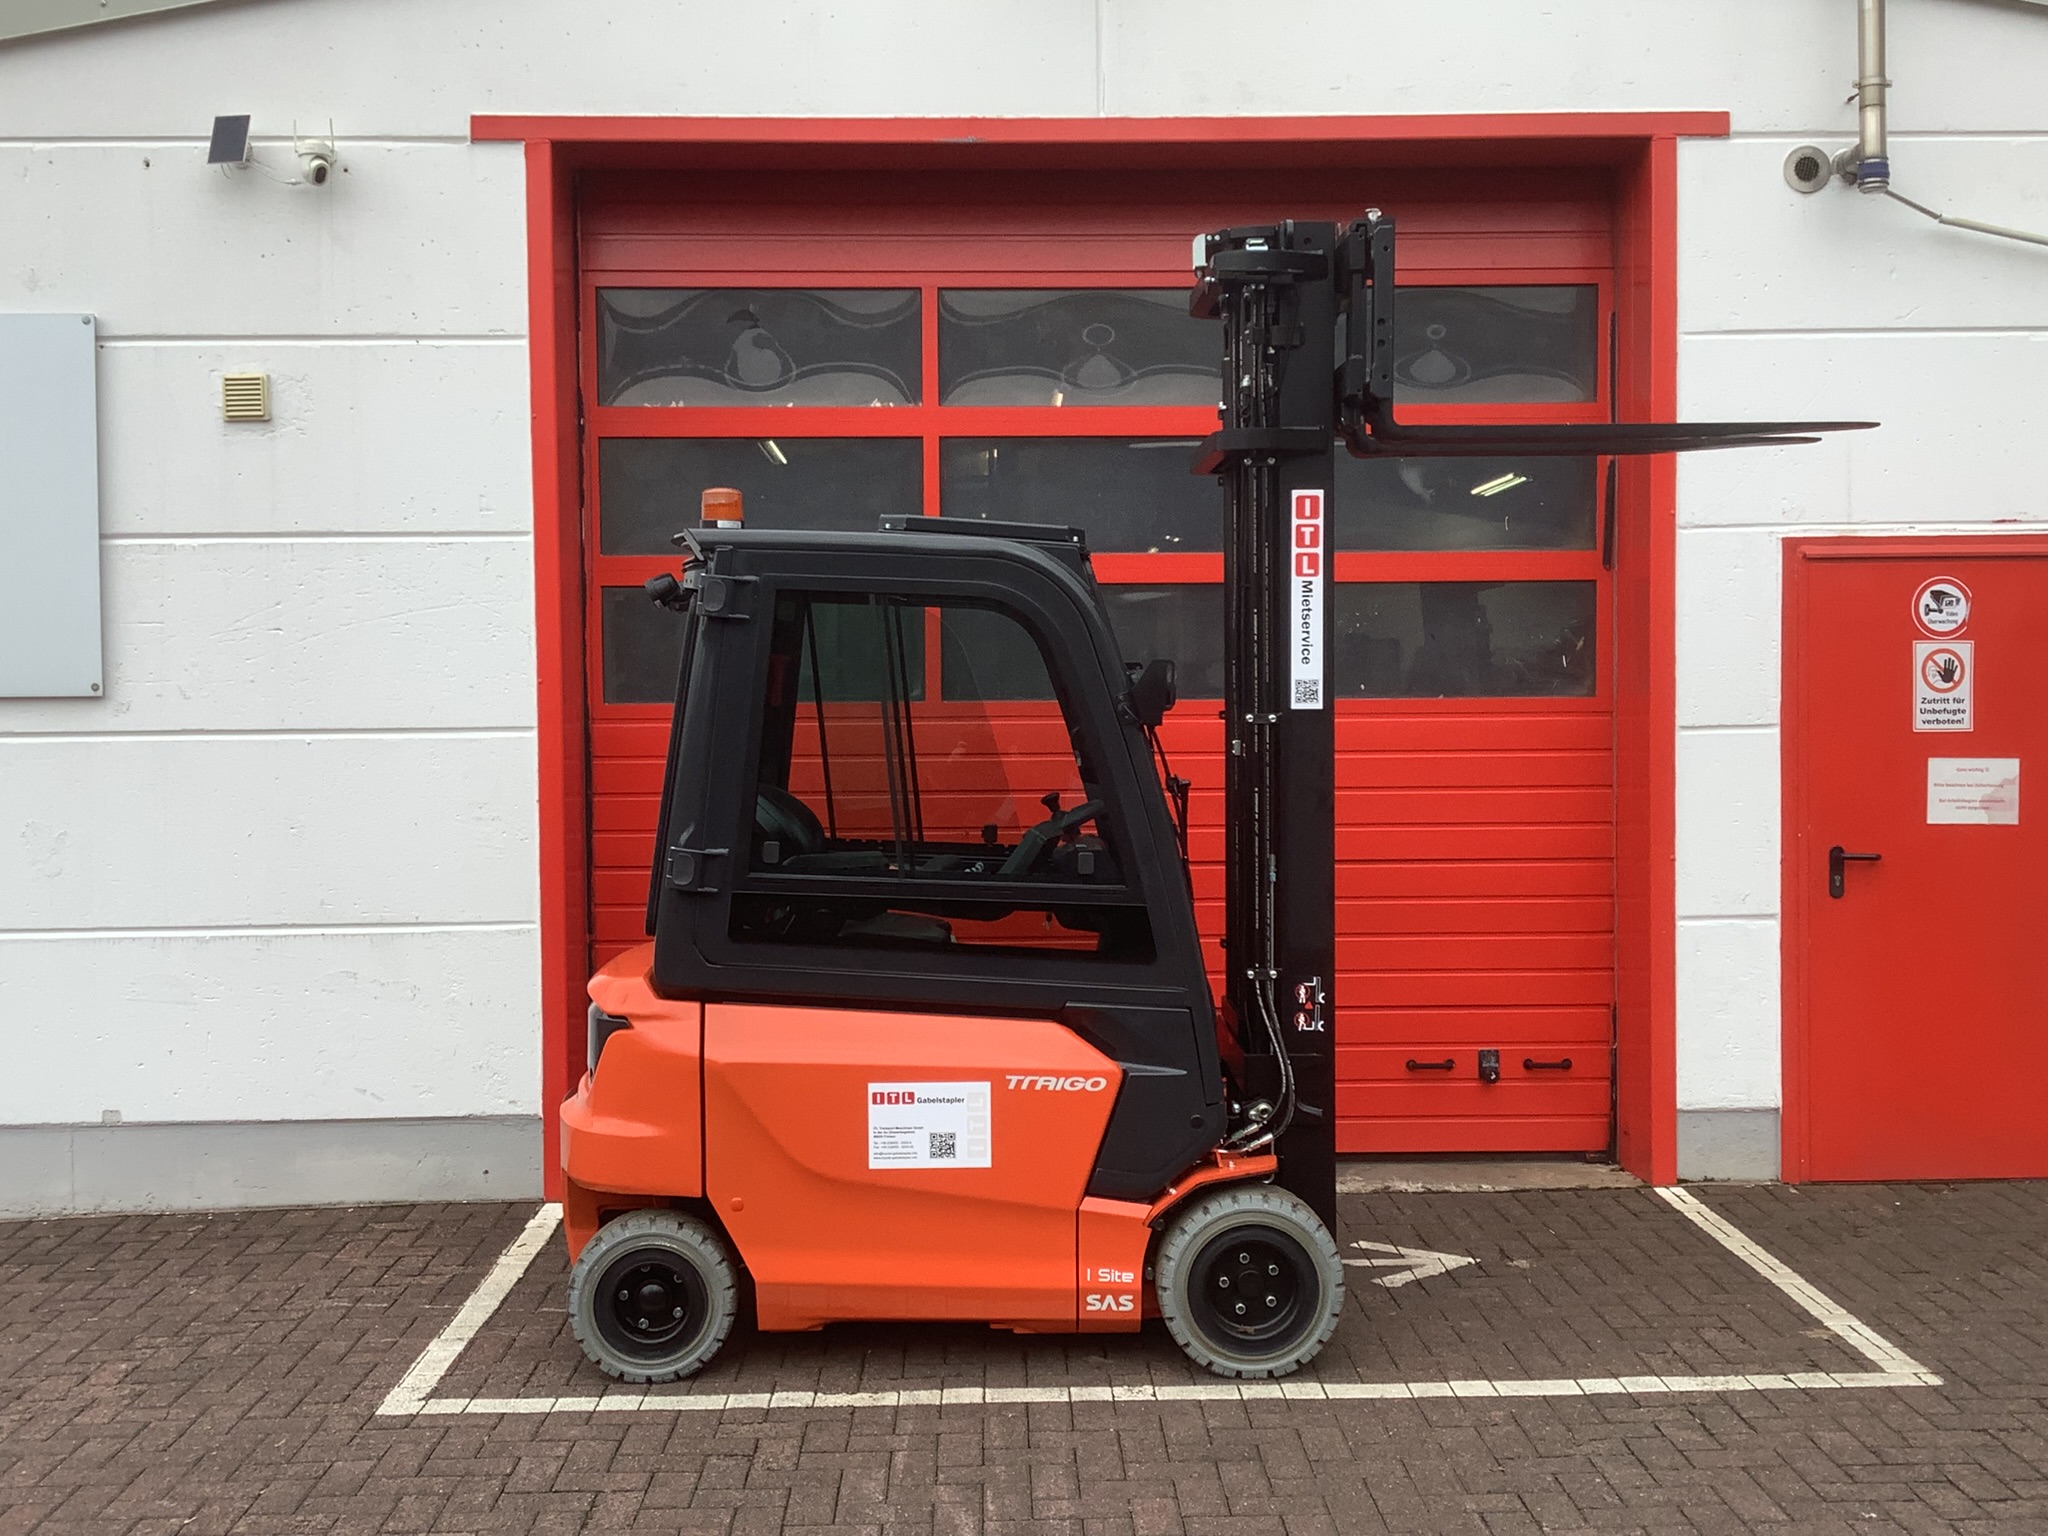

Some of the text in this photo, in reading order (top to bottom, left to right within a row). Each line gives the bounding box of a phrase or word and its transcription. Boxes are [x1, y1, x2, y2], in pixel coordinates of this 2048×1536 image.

[1299, 496, 1317, 665] ITL Mietservice
[1919, 707, 1967, 716] Unbefugte
[1921, 717, 1965, 725] verboten!
[875, 1092, 965, 1105] ITL Gabelstapler
[1097, 1268, 1135, 1283] Site
[1085, 1294, 1135, 1312] SAS
